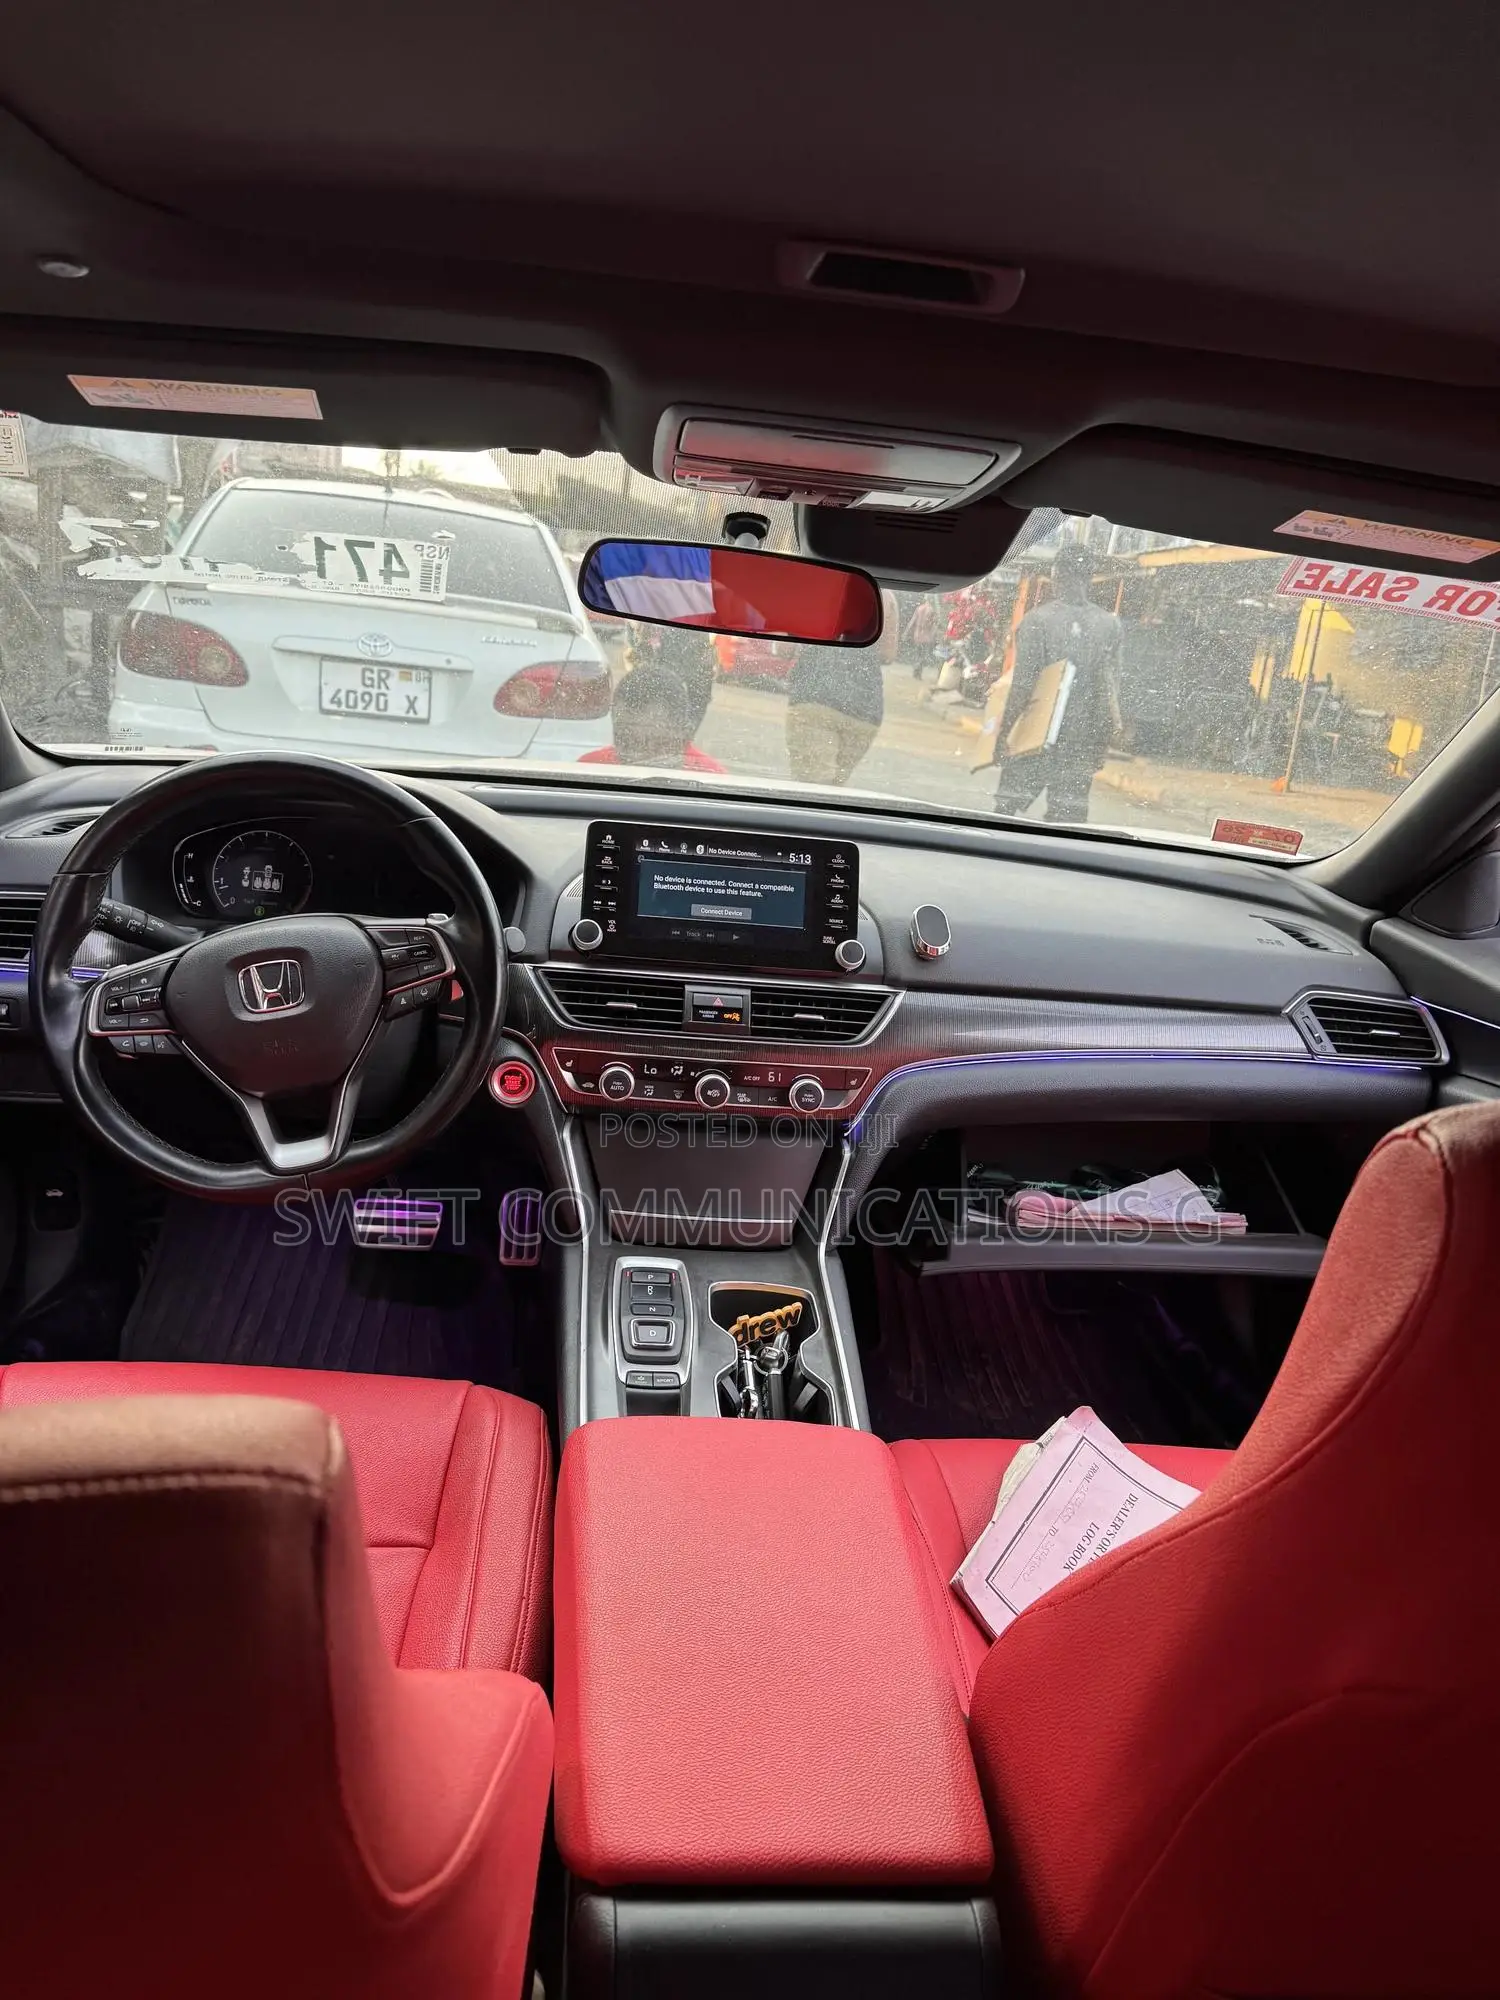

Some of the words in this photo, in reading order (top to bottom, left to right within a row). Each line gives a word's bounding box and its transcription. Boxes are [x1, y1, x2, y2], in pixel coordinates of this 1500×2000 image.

[151, 381, 283, 398] WARNING
[1362, 523, 1474, 545] WARNING
[361, 667, 391, 690] GR
[330, 689, 389, 712] 4090
[405, 695, 419, 716] X
[718, 848, 736, 856] Device
[789, 853, 812, 864] 5:13
[653, 883, 684, 891] Bluetooth
[684, 885, 705, 893] device
[726, 887, 739, 896] this
[739, 889, 763, 898] feature.
[664, 875, 685, 883] device
[693, 878, 727, 887] connected.
[728, 880, 754, 889] Connect
[760, 883, 795, 893] compatible
[700, 907, 724, 915] Connect
[724, 909, 743, 917] Device
[732, 1308, 801, 1345] drew
[1083, 1462, 1100, 1484] FROM
[1048, 1526, 1059, 1537] TO
[1083, 1521, 1100, 1546] LOG
[1096, 1537, 1111, 1554] OR
[1063, 1545, 1087, 1573] BOOK
